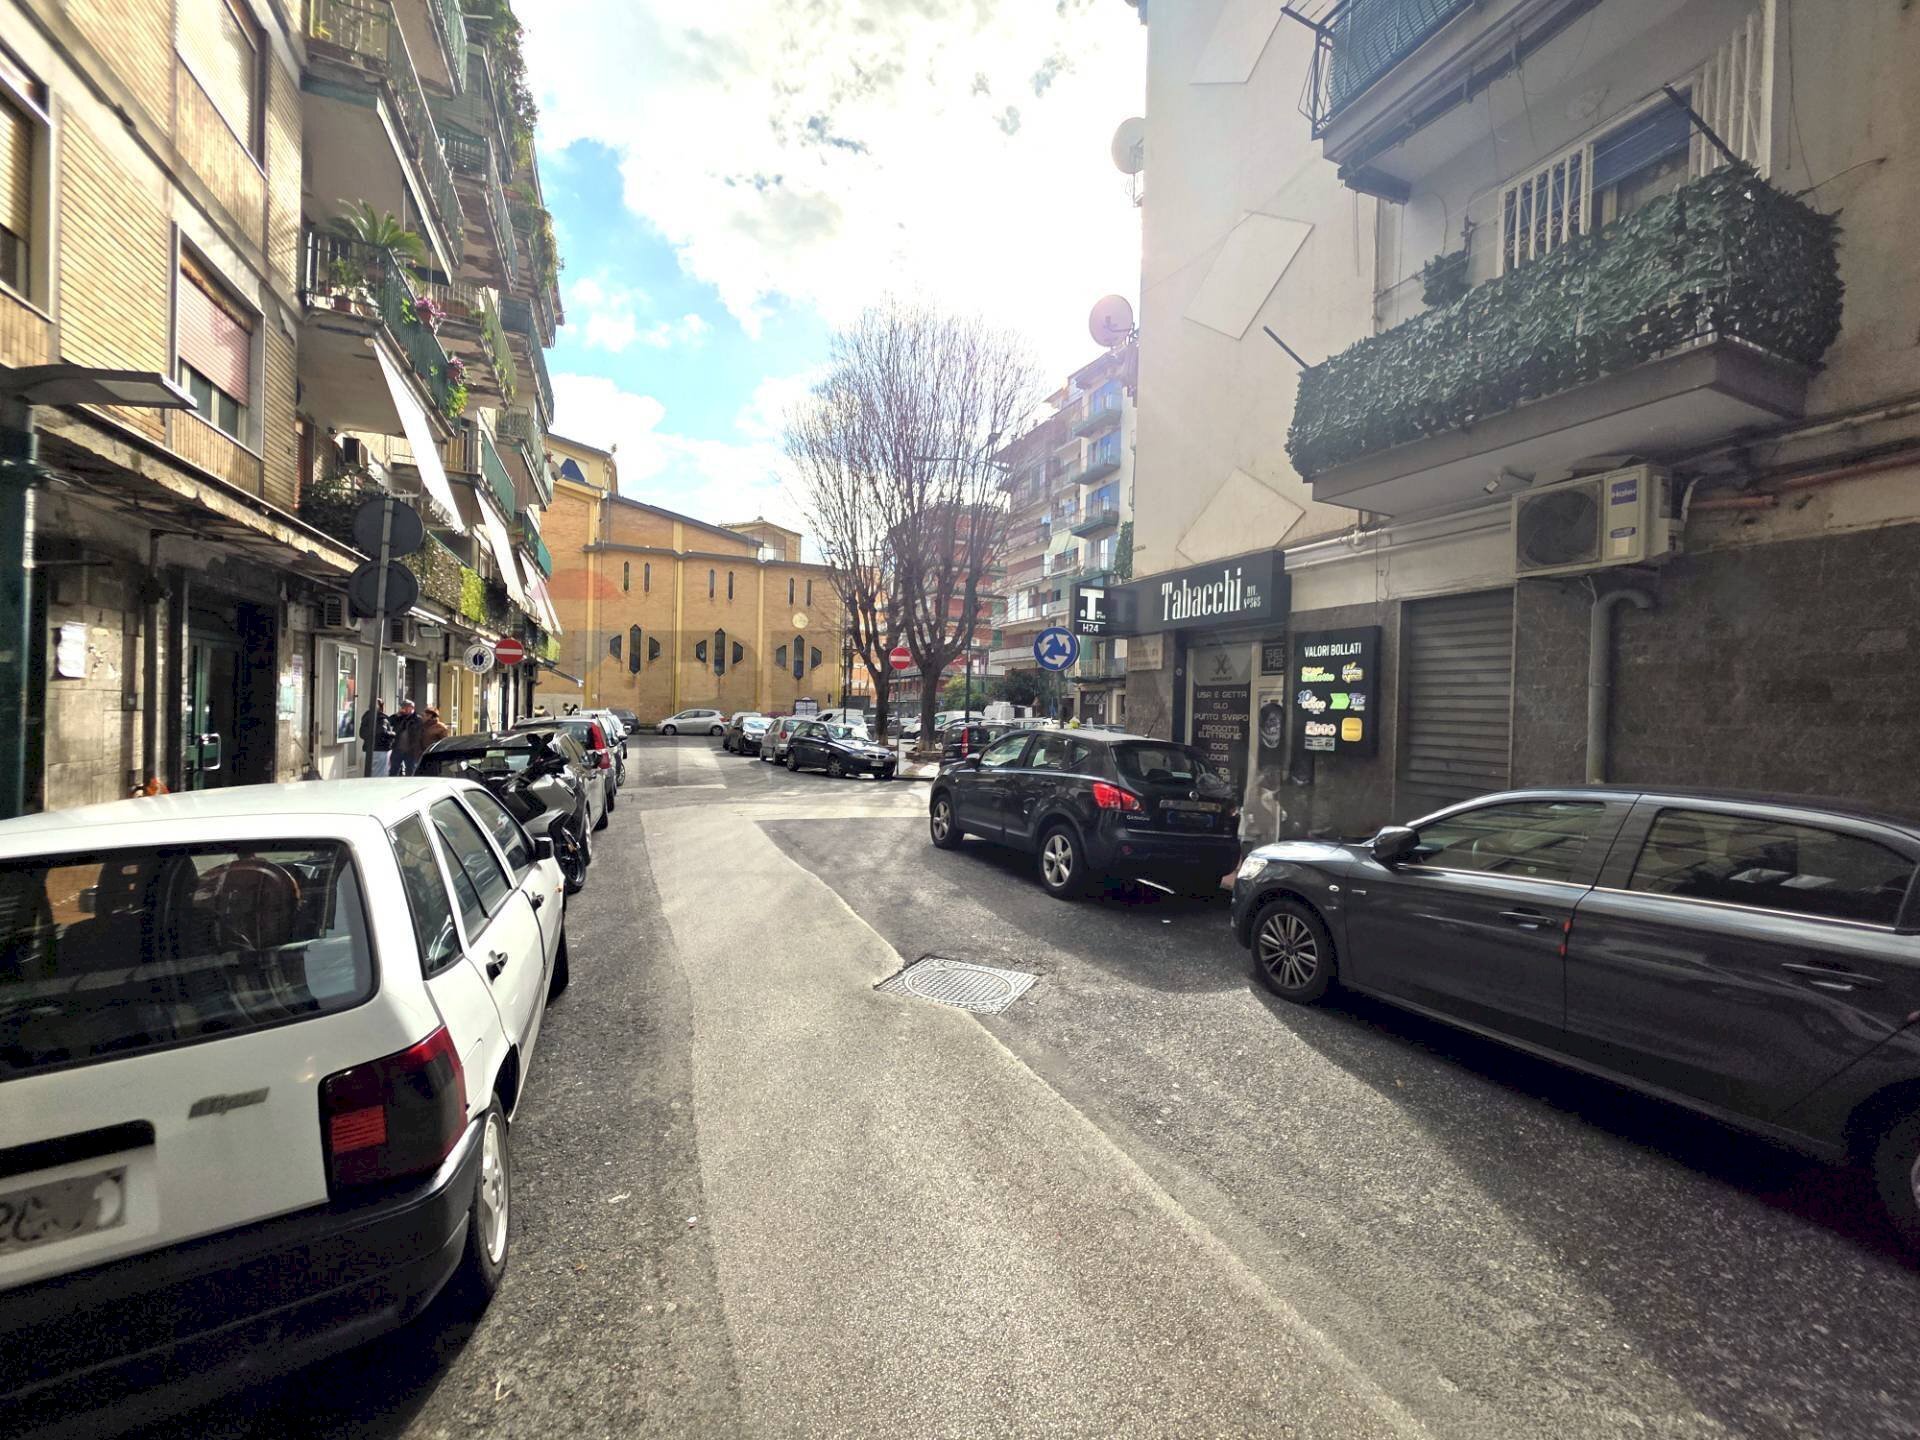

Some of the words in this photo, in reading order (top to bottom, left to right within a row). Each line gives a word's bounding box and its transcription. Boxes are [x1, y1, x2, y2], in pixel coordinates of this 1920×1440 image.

[1162, 567, 1242, 621] Tabacchi
[1082, 623, 1099, 633] H24
[1265, 648, 1284, 658] SEL
[1304, 645, 1330, 658] VALORI
[1330, 642, 1362, 656] BOLLATI
[1267, 658, 1284, 668] H2
[1197, 691, 1212, 699] USA
[1222, 690, 1248, 699] GETTA
[1213, 702, 1228, 710] GLO
[1194, 713, 1219, 721] PUNTO
[1222, 713, 1249, 721] SVAPO
[1202, 724, 1240, 732] PRODOTTI
